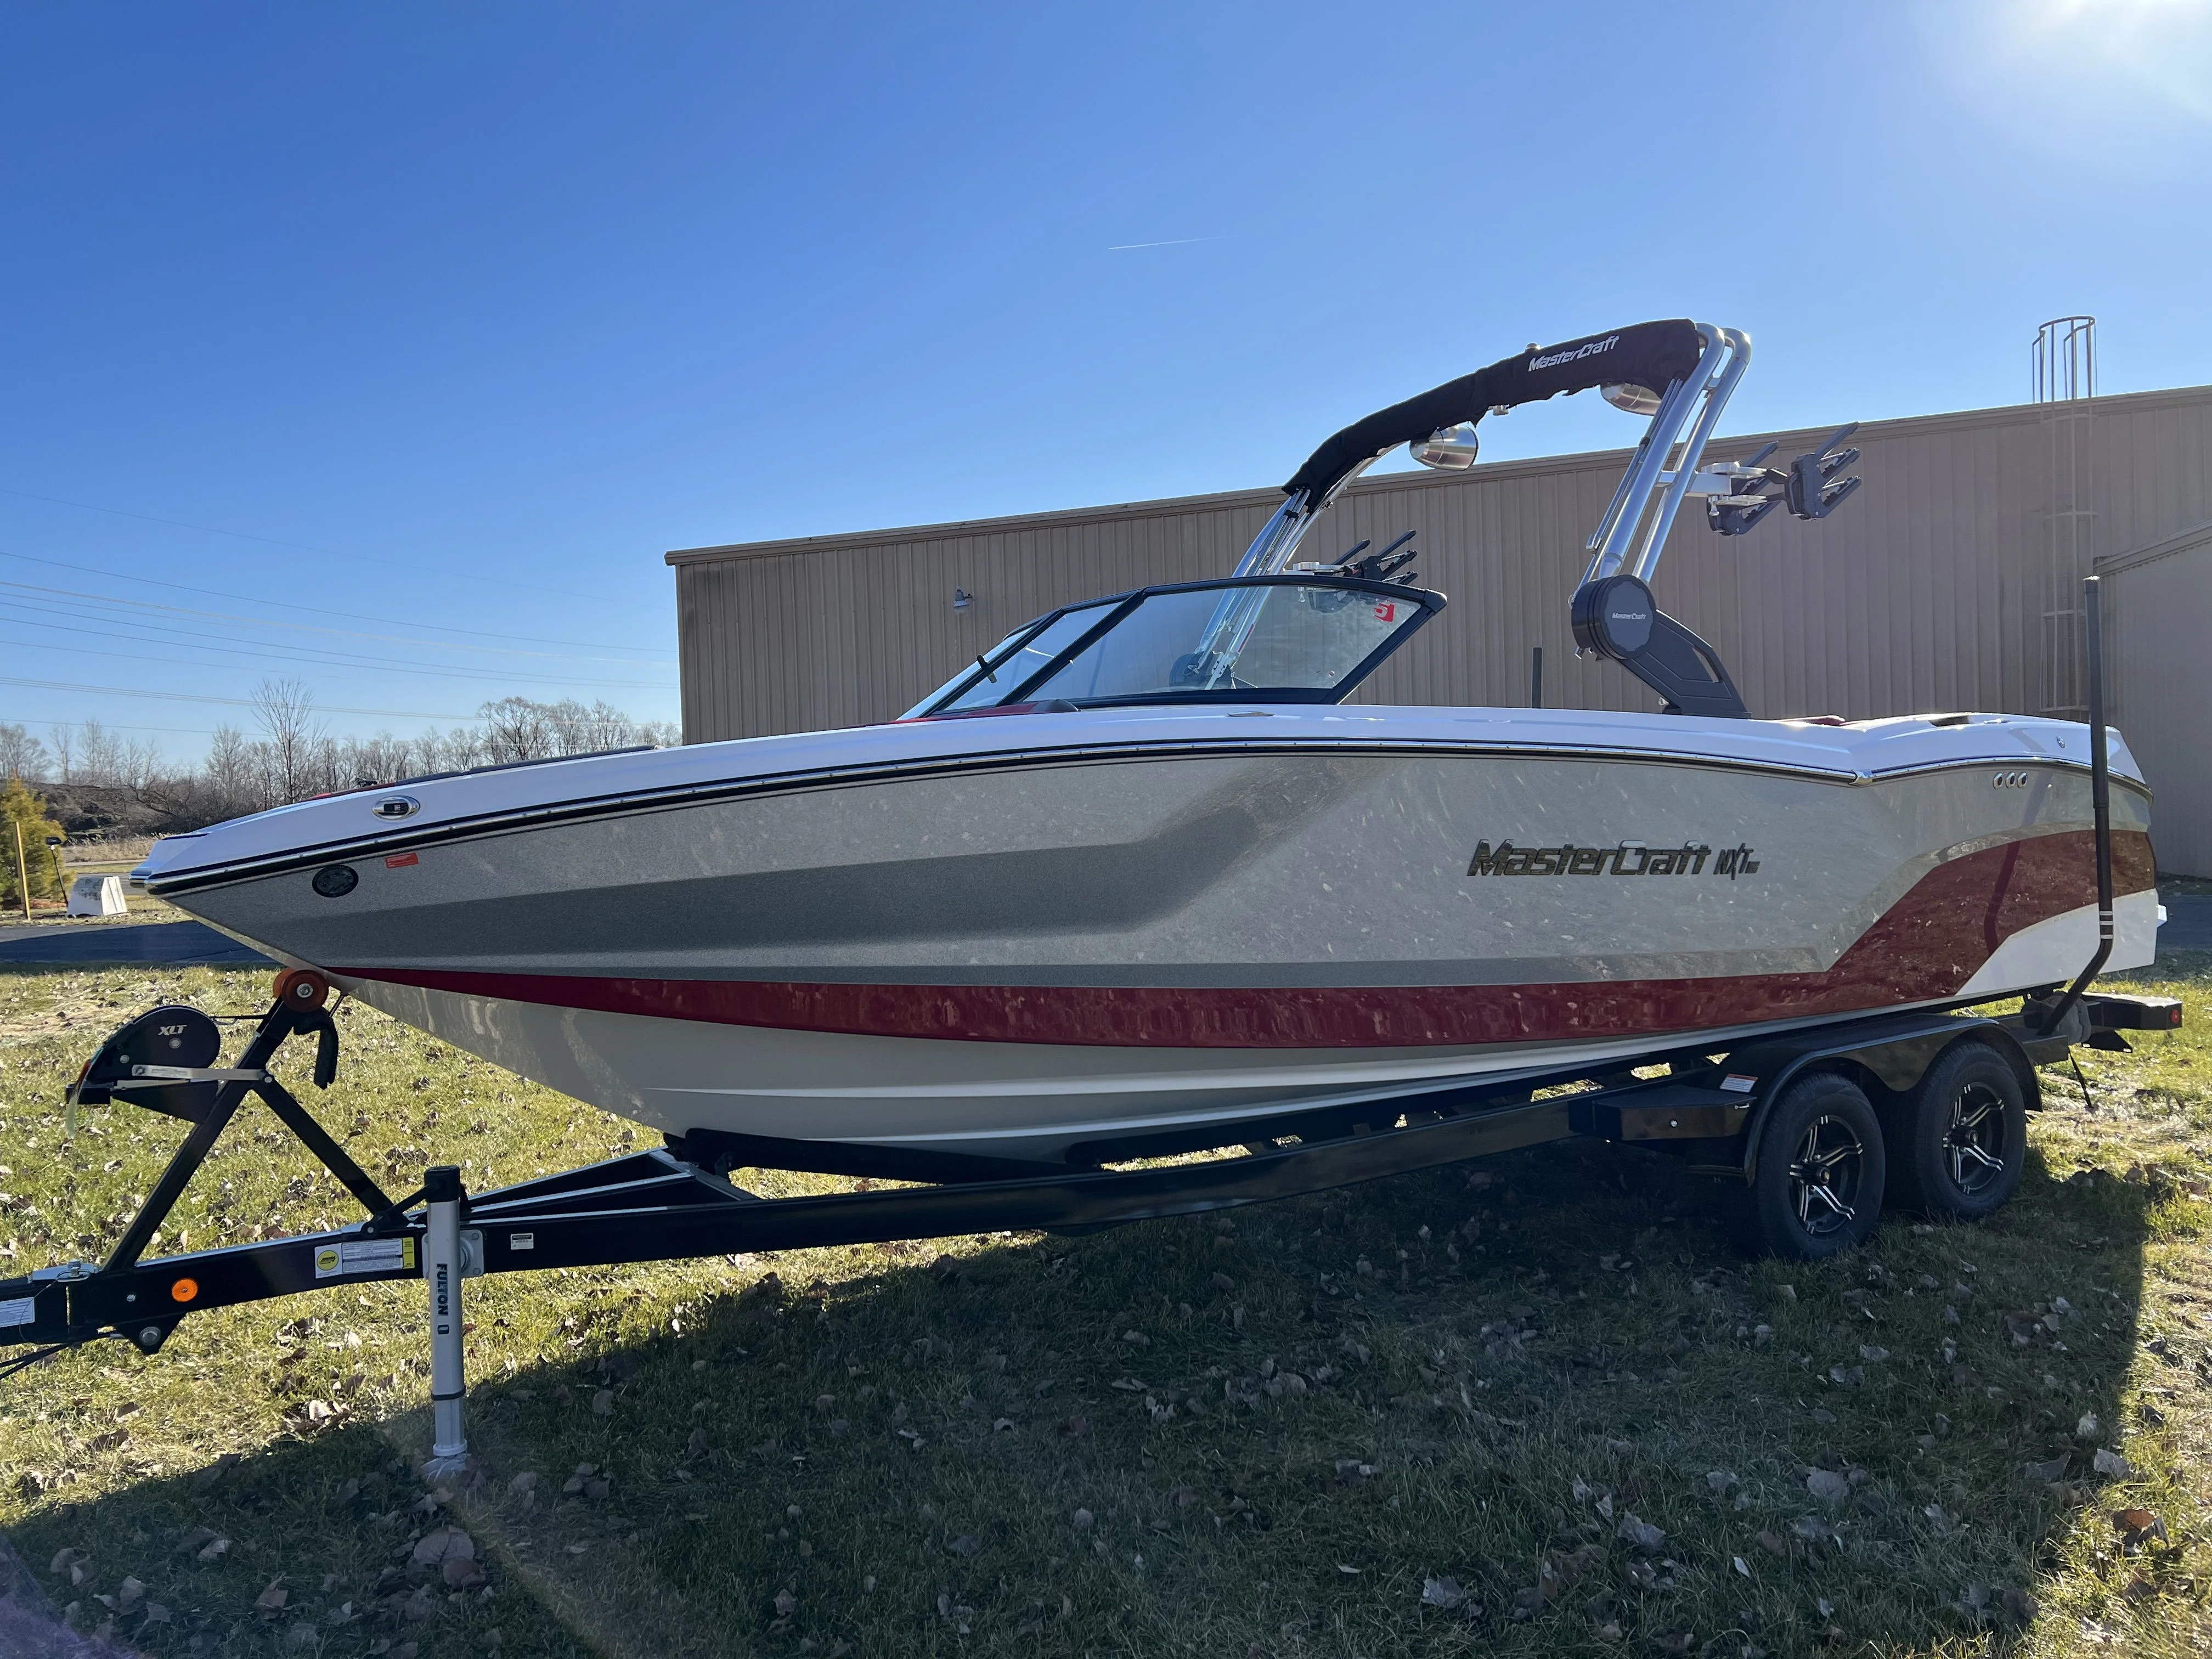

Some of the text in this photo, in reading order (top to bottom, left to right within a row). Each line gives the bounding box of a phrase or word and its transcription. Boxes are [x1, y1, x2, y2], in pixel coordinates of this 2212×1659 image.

[1528, 335, 1620, 372] MasterCraft
[1467, 839, 1712, 876] MasterCraft
[157, 1024, 187, 1036] XLT
[437, 1263, 448, 1315] FULTON
